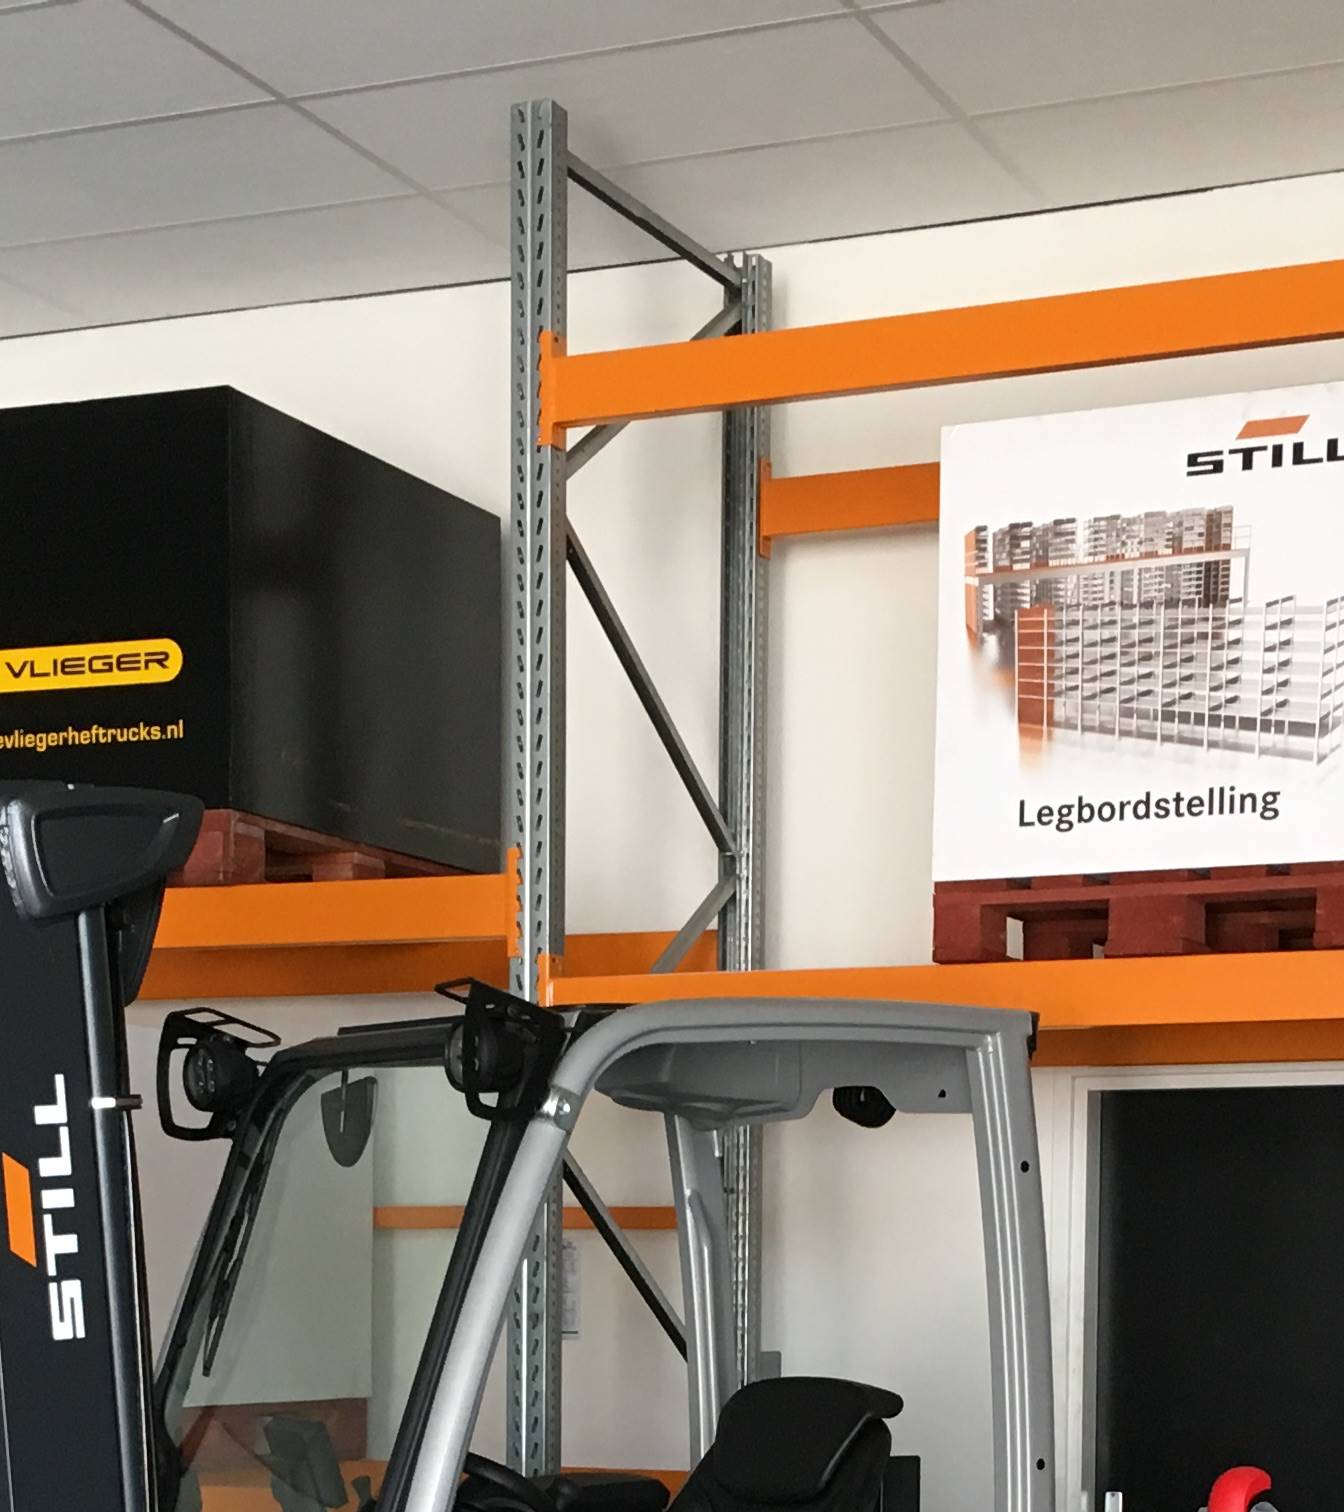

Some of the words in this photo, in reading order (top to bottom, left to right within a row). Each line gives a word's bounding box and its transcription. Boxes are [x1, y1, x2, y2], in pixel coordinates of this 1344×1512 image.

[5, 651, 170, 679] VLIEGER
[1018, 786, 1281, 833] Legbordstelling
[33, 1073, 86, 1341] STILL
